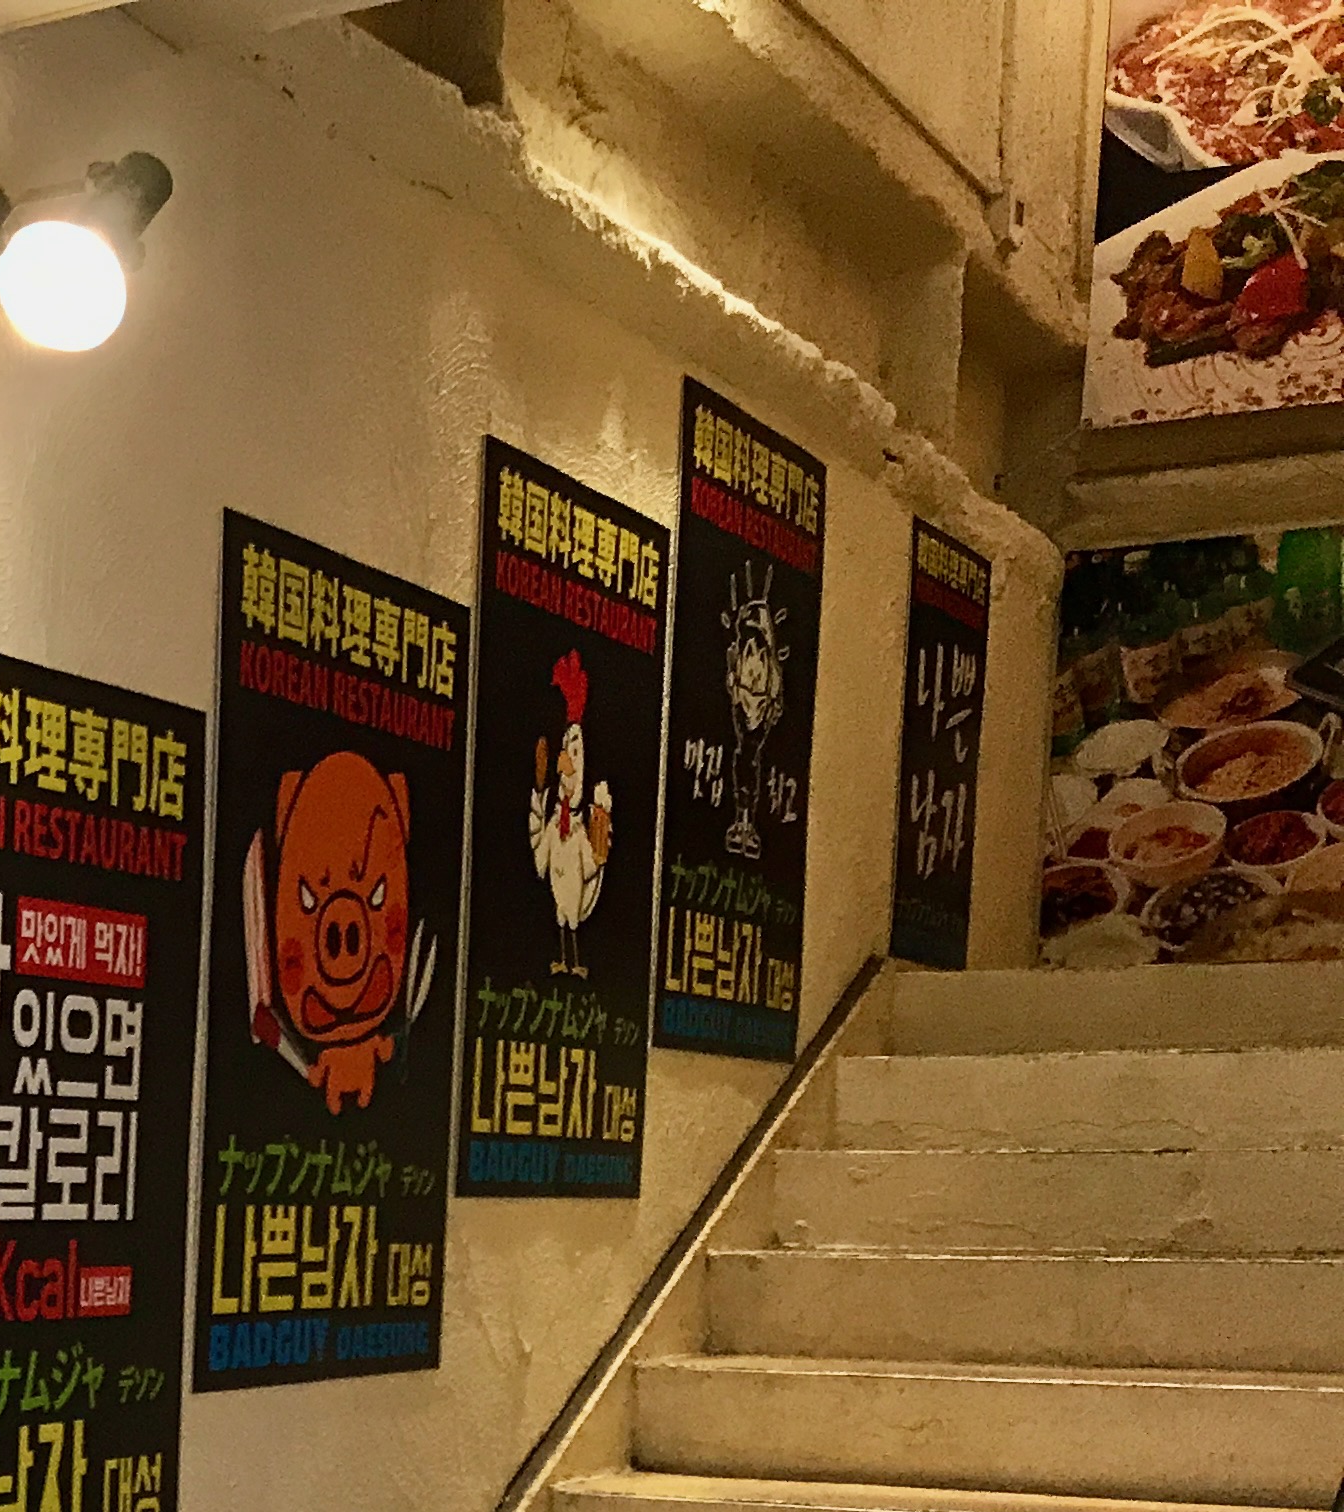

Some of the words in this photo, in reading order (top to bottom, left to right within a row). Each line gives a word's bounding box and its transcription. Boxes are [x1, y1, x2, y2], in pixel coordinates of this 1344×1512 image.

[241, 543, 457, 700] 韓国料理専門店
[239, 639, 329, 712] KOREAN
[333, 670, 456, 752] RESTAURANT
[13, 799, 188, 881] RESTAURANT
[21, 909, 87, 970] 맛있게
[94, 921, 144, 978] 먹자!
[470, 1036, 597, 1139] 나쁜남자
[217, 1133, 393, 1199] ナップンナムジャ
[211, 1203, 379, 1316] 나쁜남자
[386, 1243, 433, 1307] 대성
[208, 1317, 330, 1372] BADGUY
